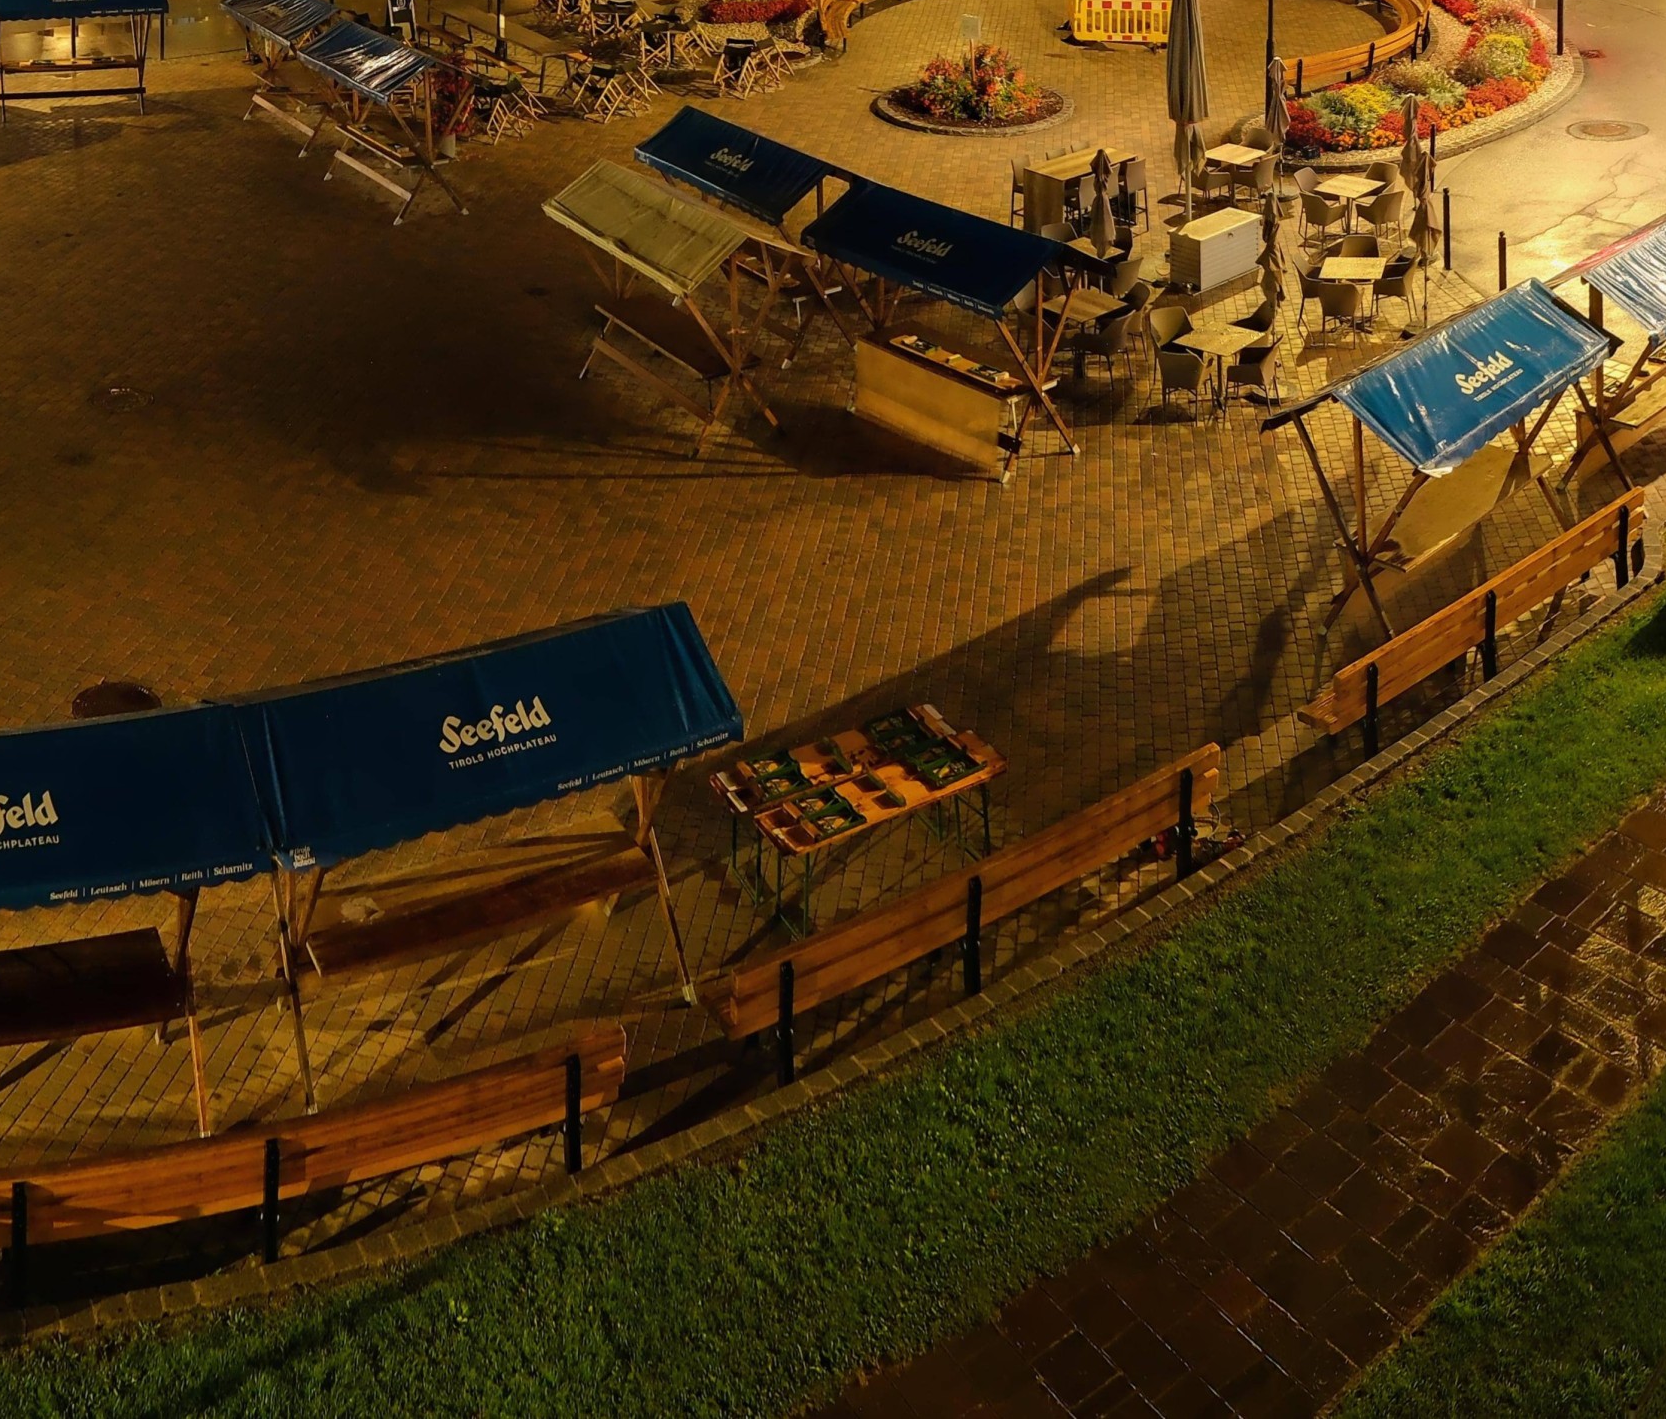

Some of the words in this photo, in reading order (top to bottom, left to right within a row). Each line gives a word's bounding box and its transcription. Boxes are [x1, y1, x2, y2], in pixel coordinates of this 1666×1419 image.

[709, 147, 755, 172] Seefeld
[896, 230, 954, 258] Seefeld
[1455, 350, 1514, 395] Seefeld
[438, 695, 552, 755] Seefeld
[448, 752, 486, 771] TIROLS
[486, 733, 558, 760] HOCHPLATEAU
